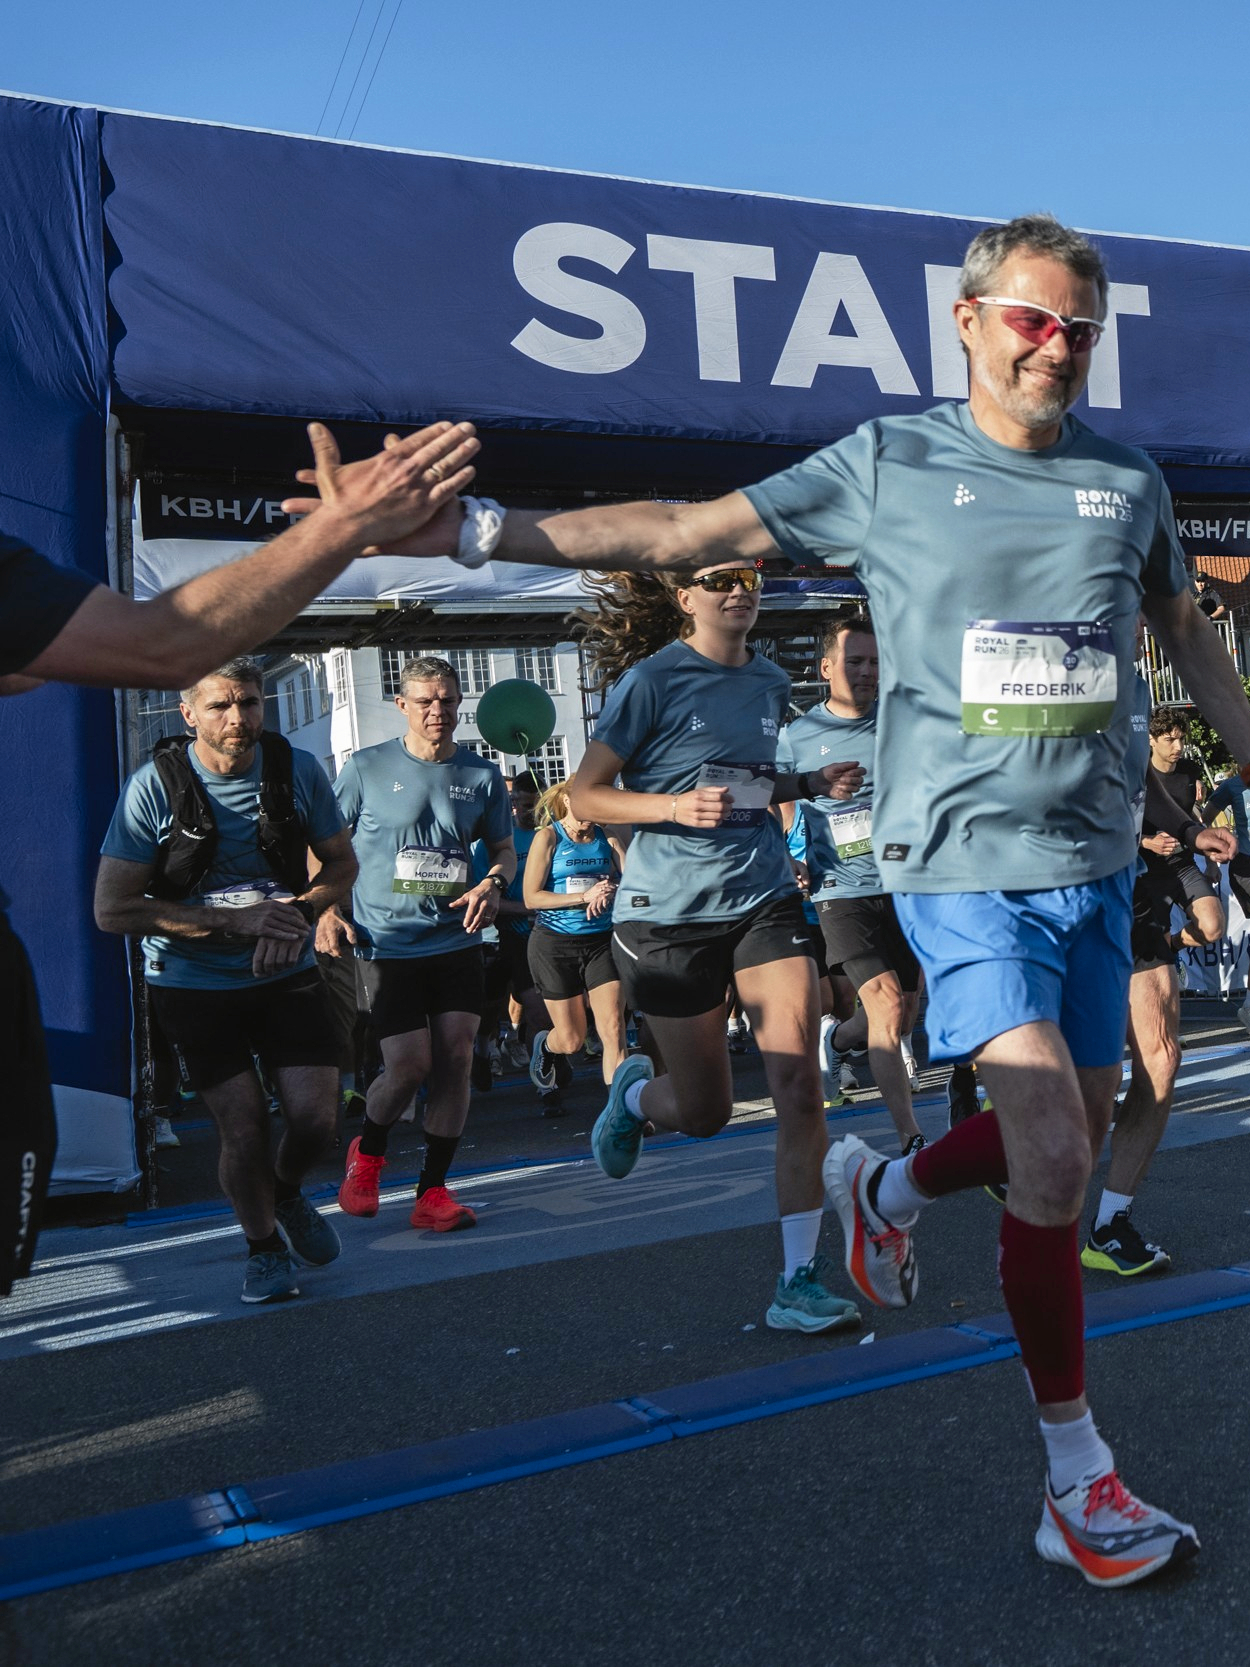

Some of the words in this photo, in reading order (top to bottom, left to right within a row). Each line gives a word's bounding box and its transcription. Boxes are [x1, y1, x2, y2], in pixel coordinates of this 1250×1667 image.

[1075, 489, 1132, 509] ROYAL
[975, 637, 1009, 651] ROYAL
[1001, 682, 1086, 696] FREDERIK
[982, 708, 999, 726] C
[1041, 708, 1048, 726] 1
[449, 785, 476, 796] ROYAL
[565, 857, 610, 867] SPARTA
[414, 871, 449, 879] MORTEN
[402, 881, 410, 889] C
[417, 882, 446, 891] 121877
